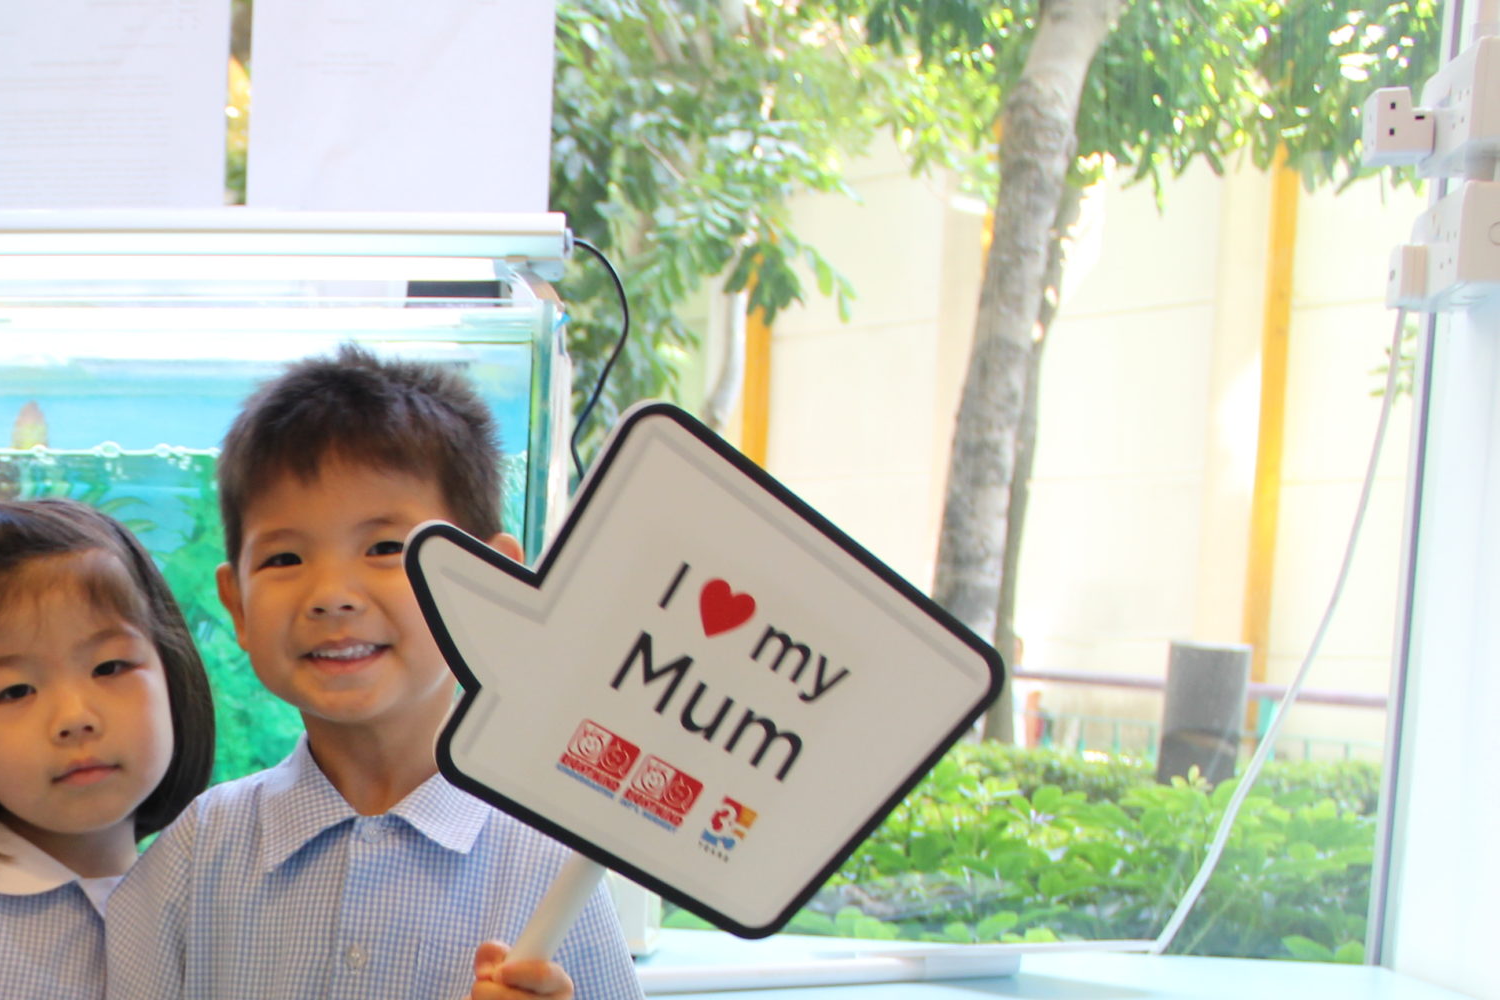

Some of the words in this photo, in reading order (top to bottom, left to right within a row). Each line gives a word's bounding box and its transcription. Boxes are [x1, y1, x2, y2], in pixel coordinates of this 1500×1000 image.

[610, 630, 803, 782] Mum
[659, 562, 690, 609] I
[750, 625, 850, 704] my
